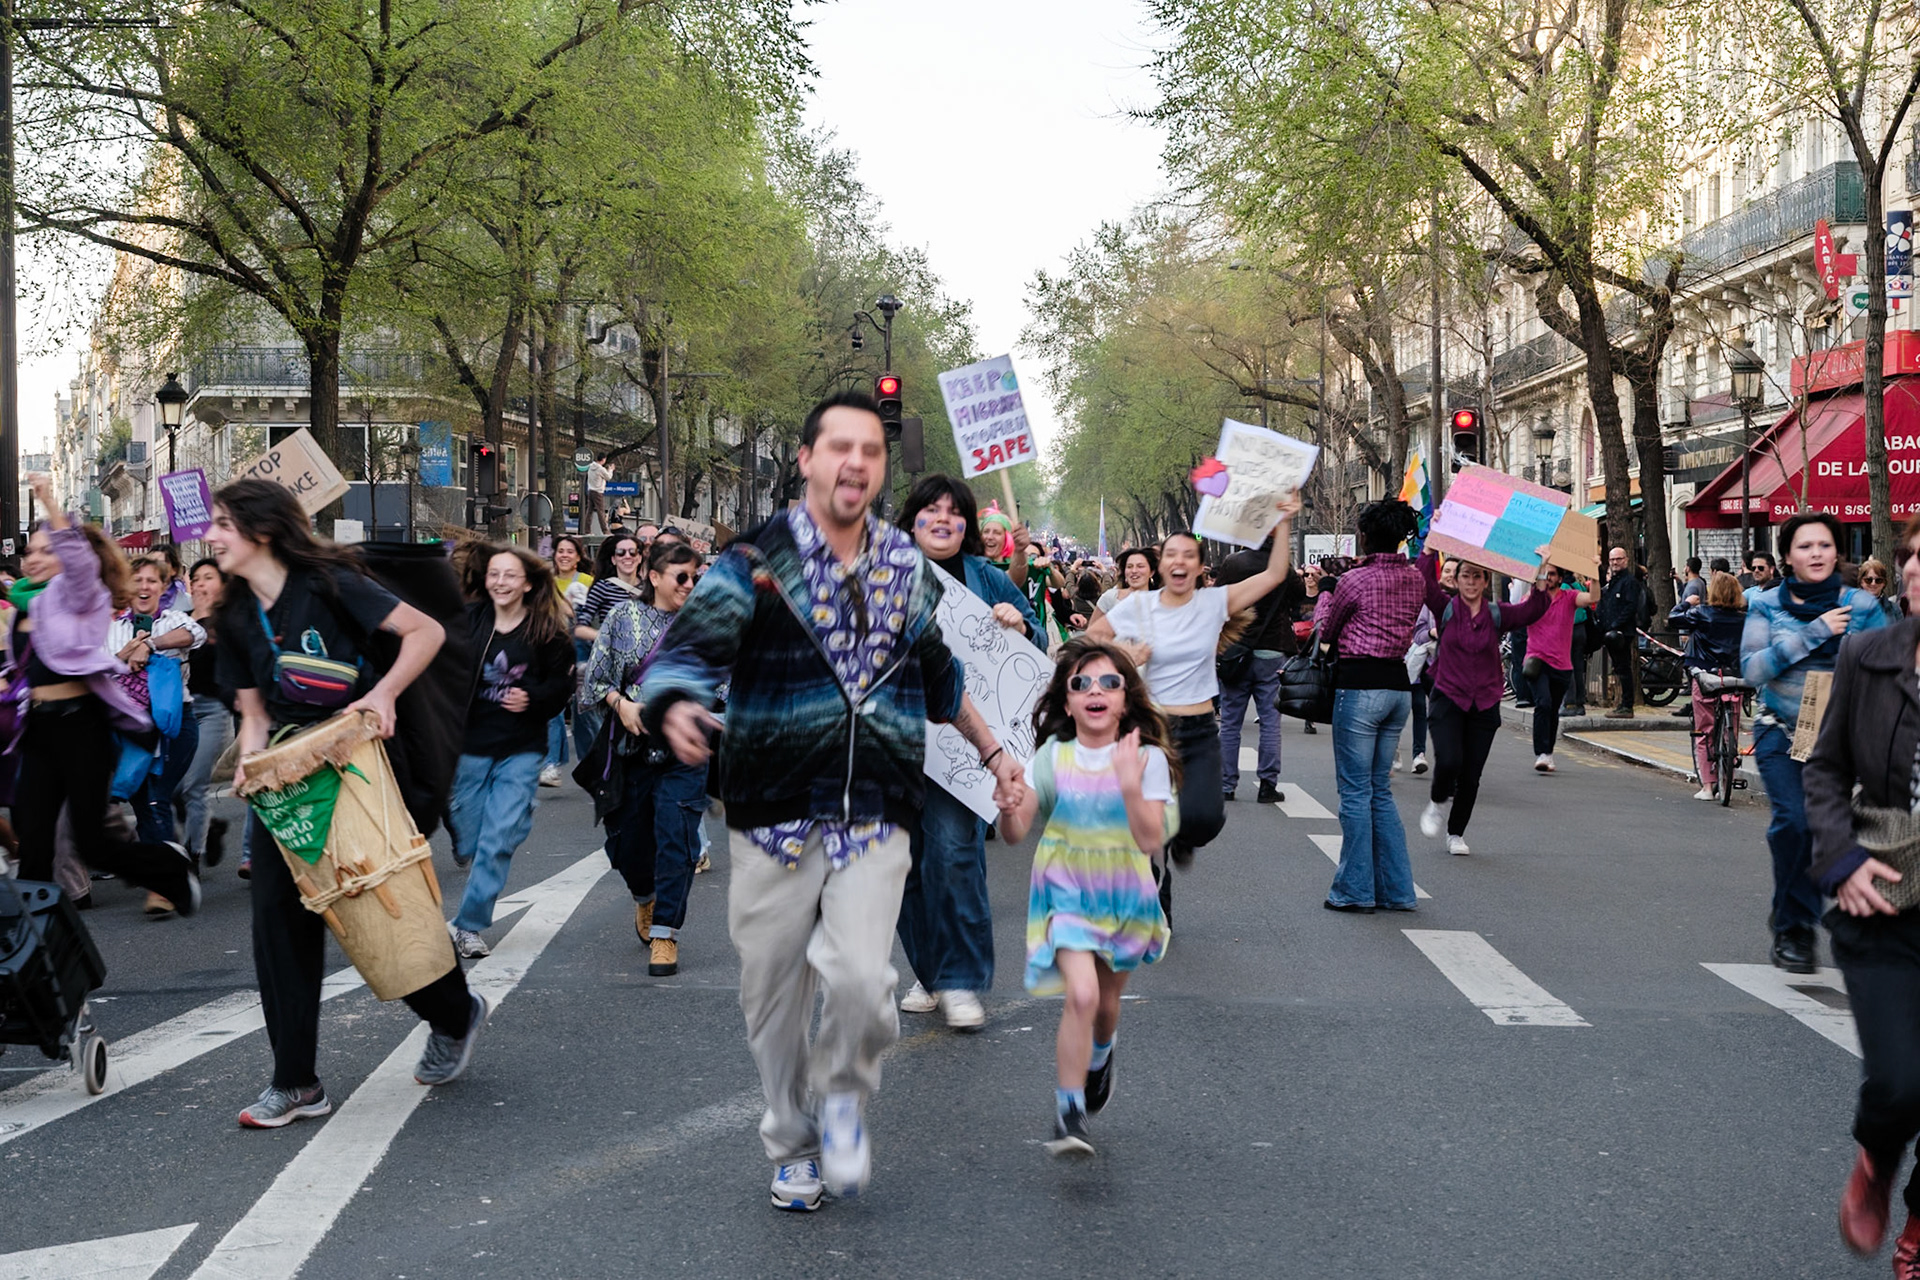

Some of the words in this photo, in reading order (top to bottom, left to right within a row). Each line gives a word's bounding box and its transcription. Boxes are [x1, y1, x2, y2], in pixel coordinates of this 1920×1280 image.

[1819, 235, 1835, 284] TABAC
[946, 369, 1001, 402] KEEP
[961, 415, 1028, 451] WOMEN
[575, 453, 591, 461] BUS
[972, 434, 1031, 472] SAFE
[1818, 461, 1843, 476] DE
[1848, 461, 1869, 476] LA
[1822, 505, 1839, 515] AU
[1891, 504, 1904, 514] 01
[1907, 503, 1920, 514] 42
[272, 820, 314, 841] borto
